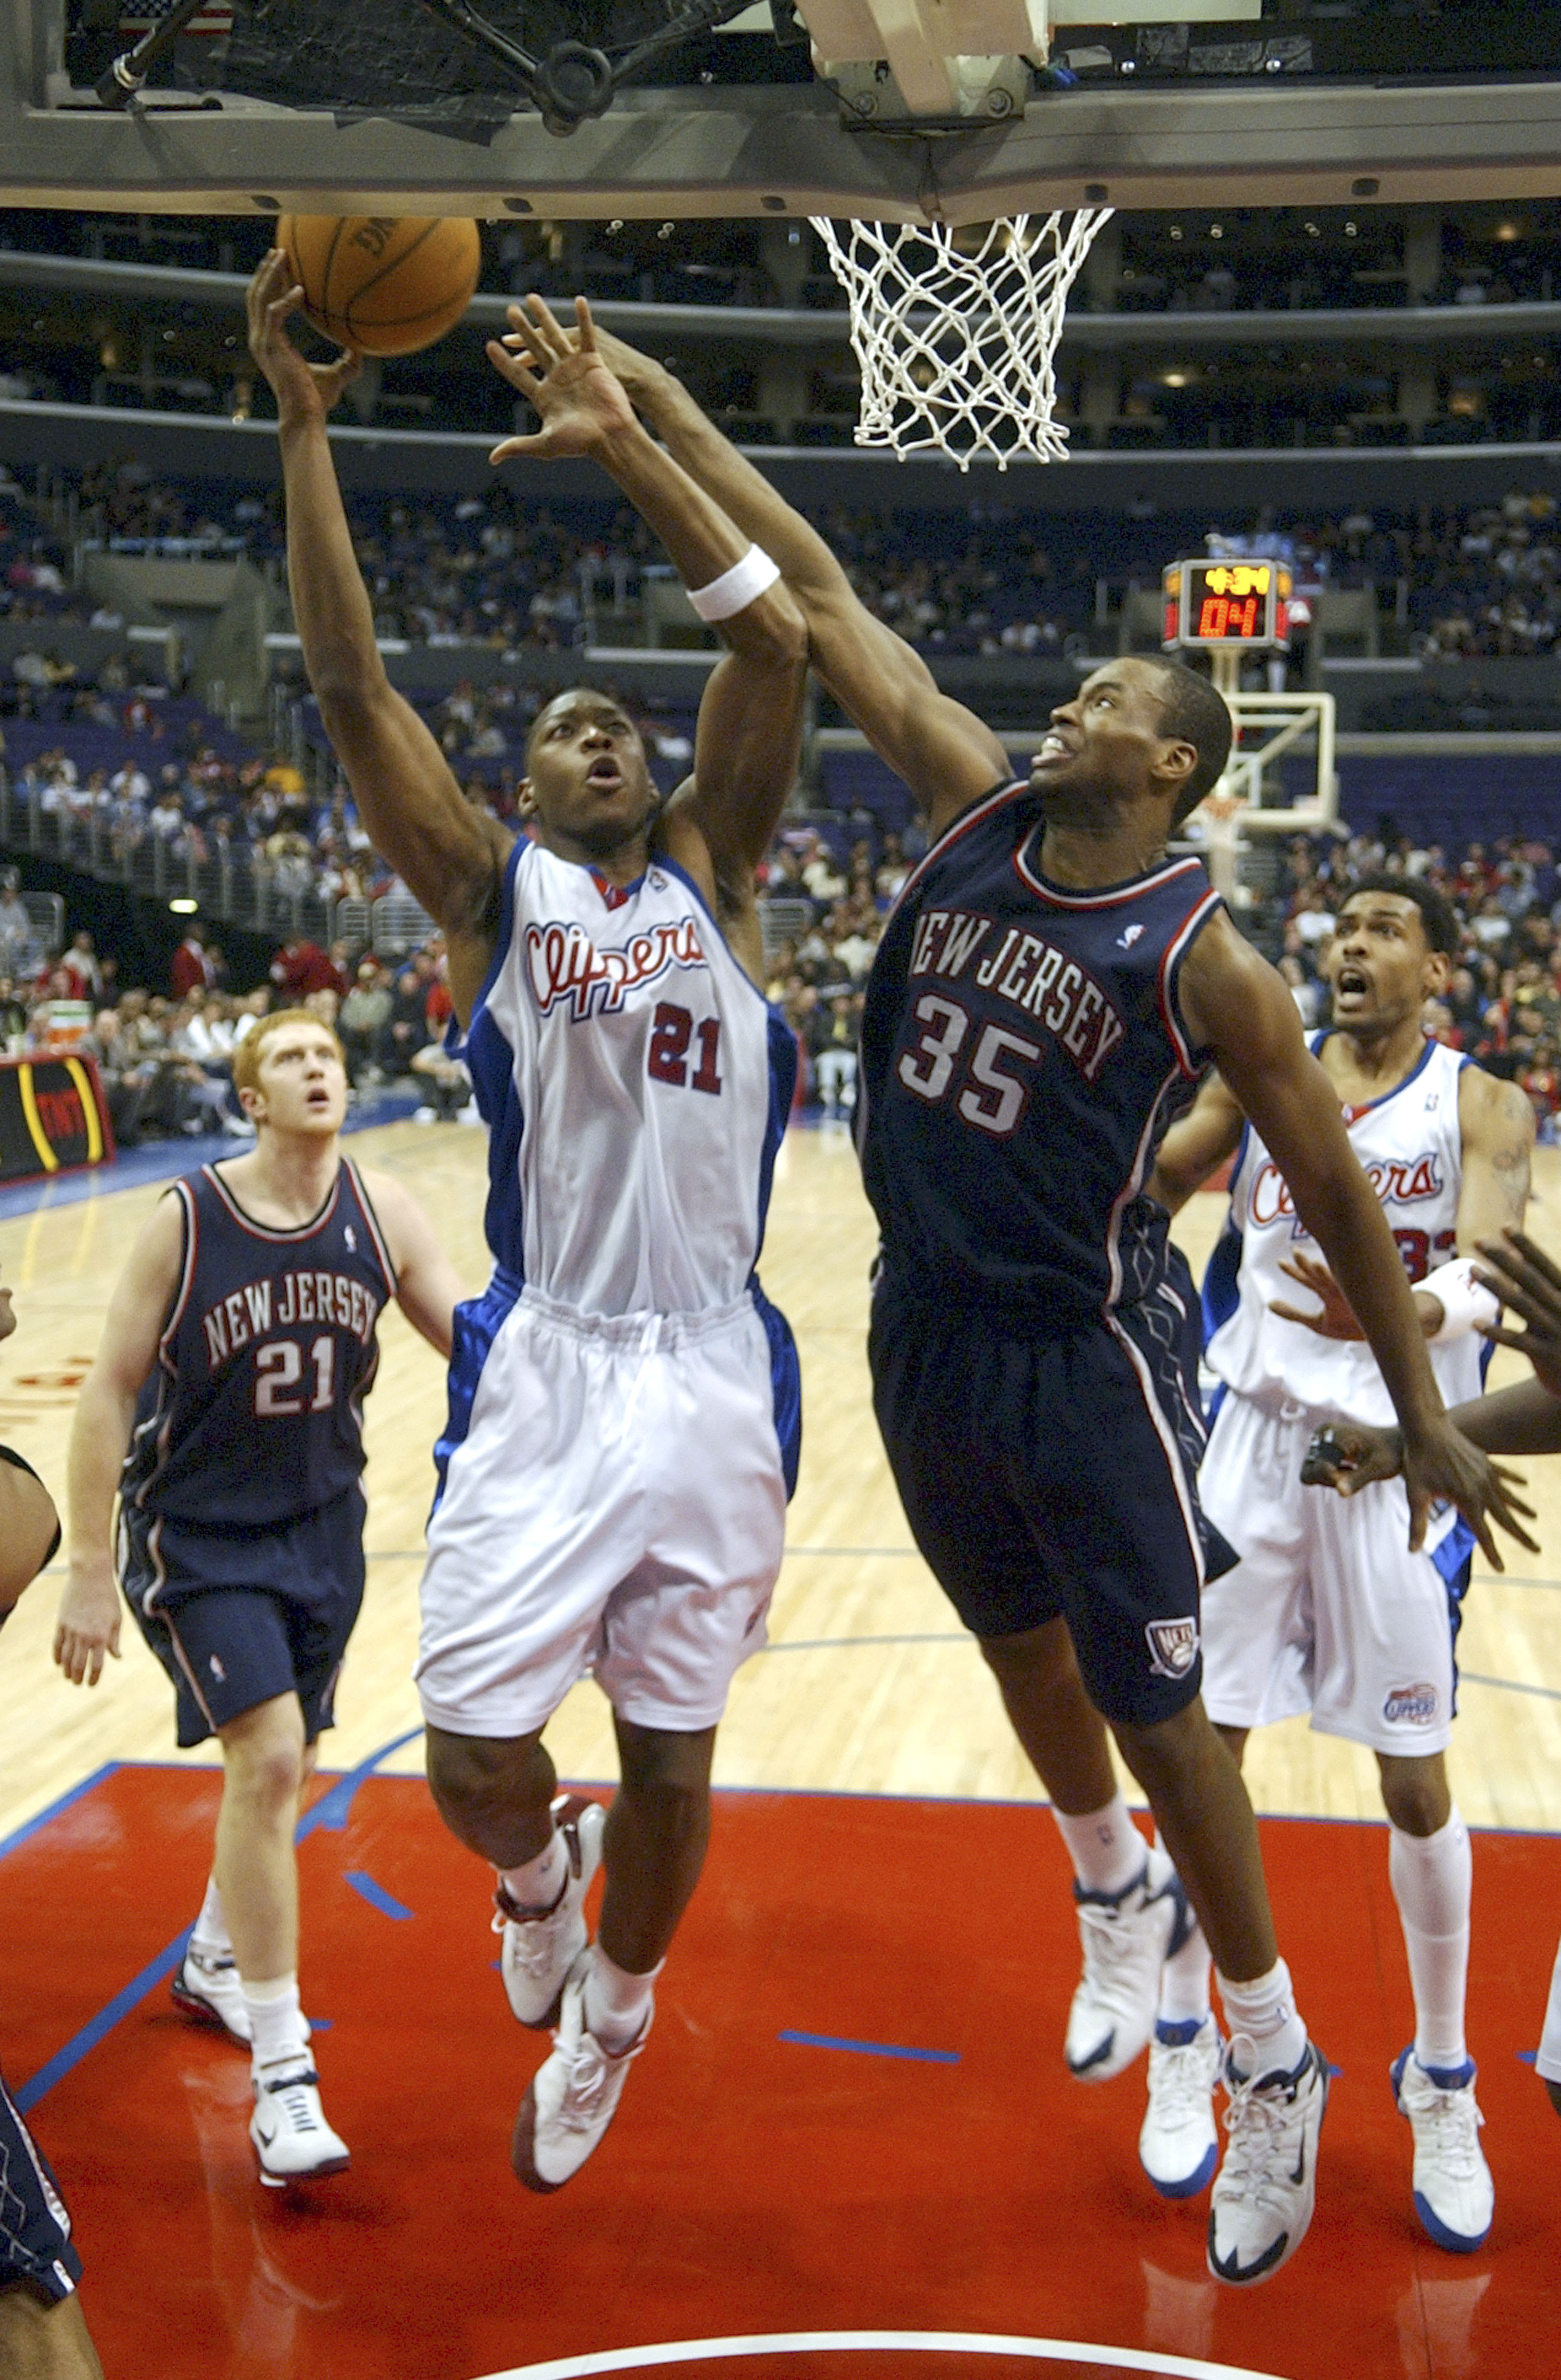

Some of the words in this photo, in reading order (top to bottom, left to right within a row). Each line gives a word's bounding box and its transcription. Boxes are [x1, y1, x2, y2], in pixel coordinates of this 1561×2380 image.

[1198, 599, 1257, 638] 04
[526, 916, 708, 1024] Clippers
[976, 928, 1124, 1081] JERSEY
[648, 1001, 722, 1096] 21
[897, 993, 1041, 1134] 35
[203, 1279, 272, 1367] NEW
[277, 1271, 377, 1346] JERSEY
[255, 1335, 335, 1417] 21
